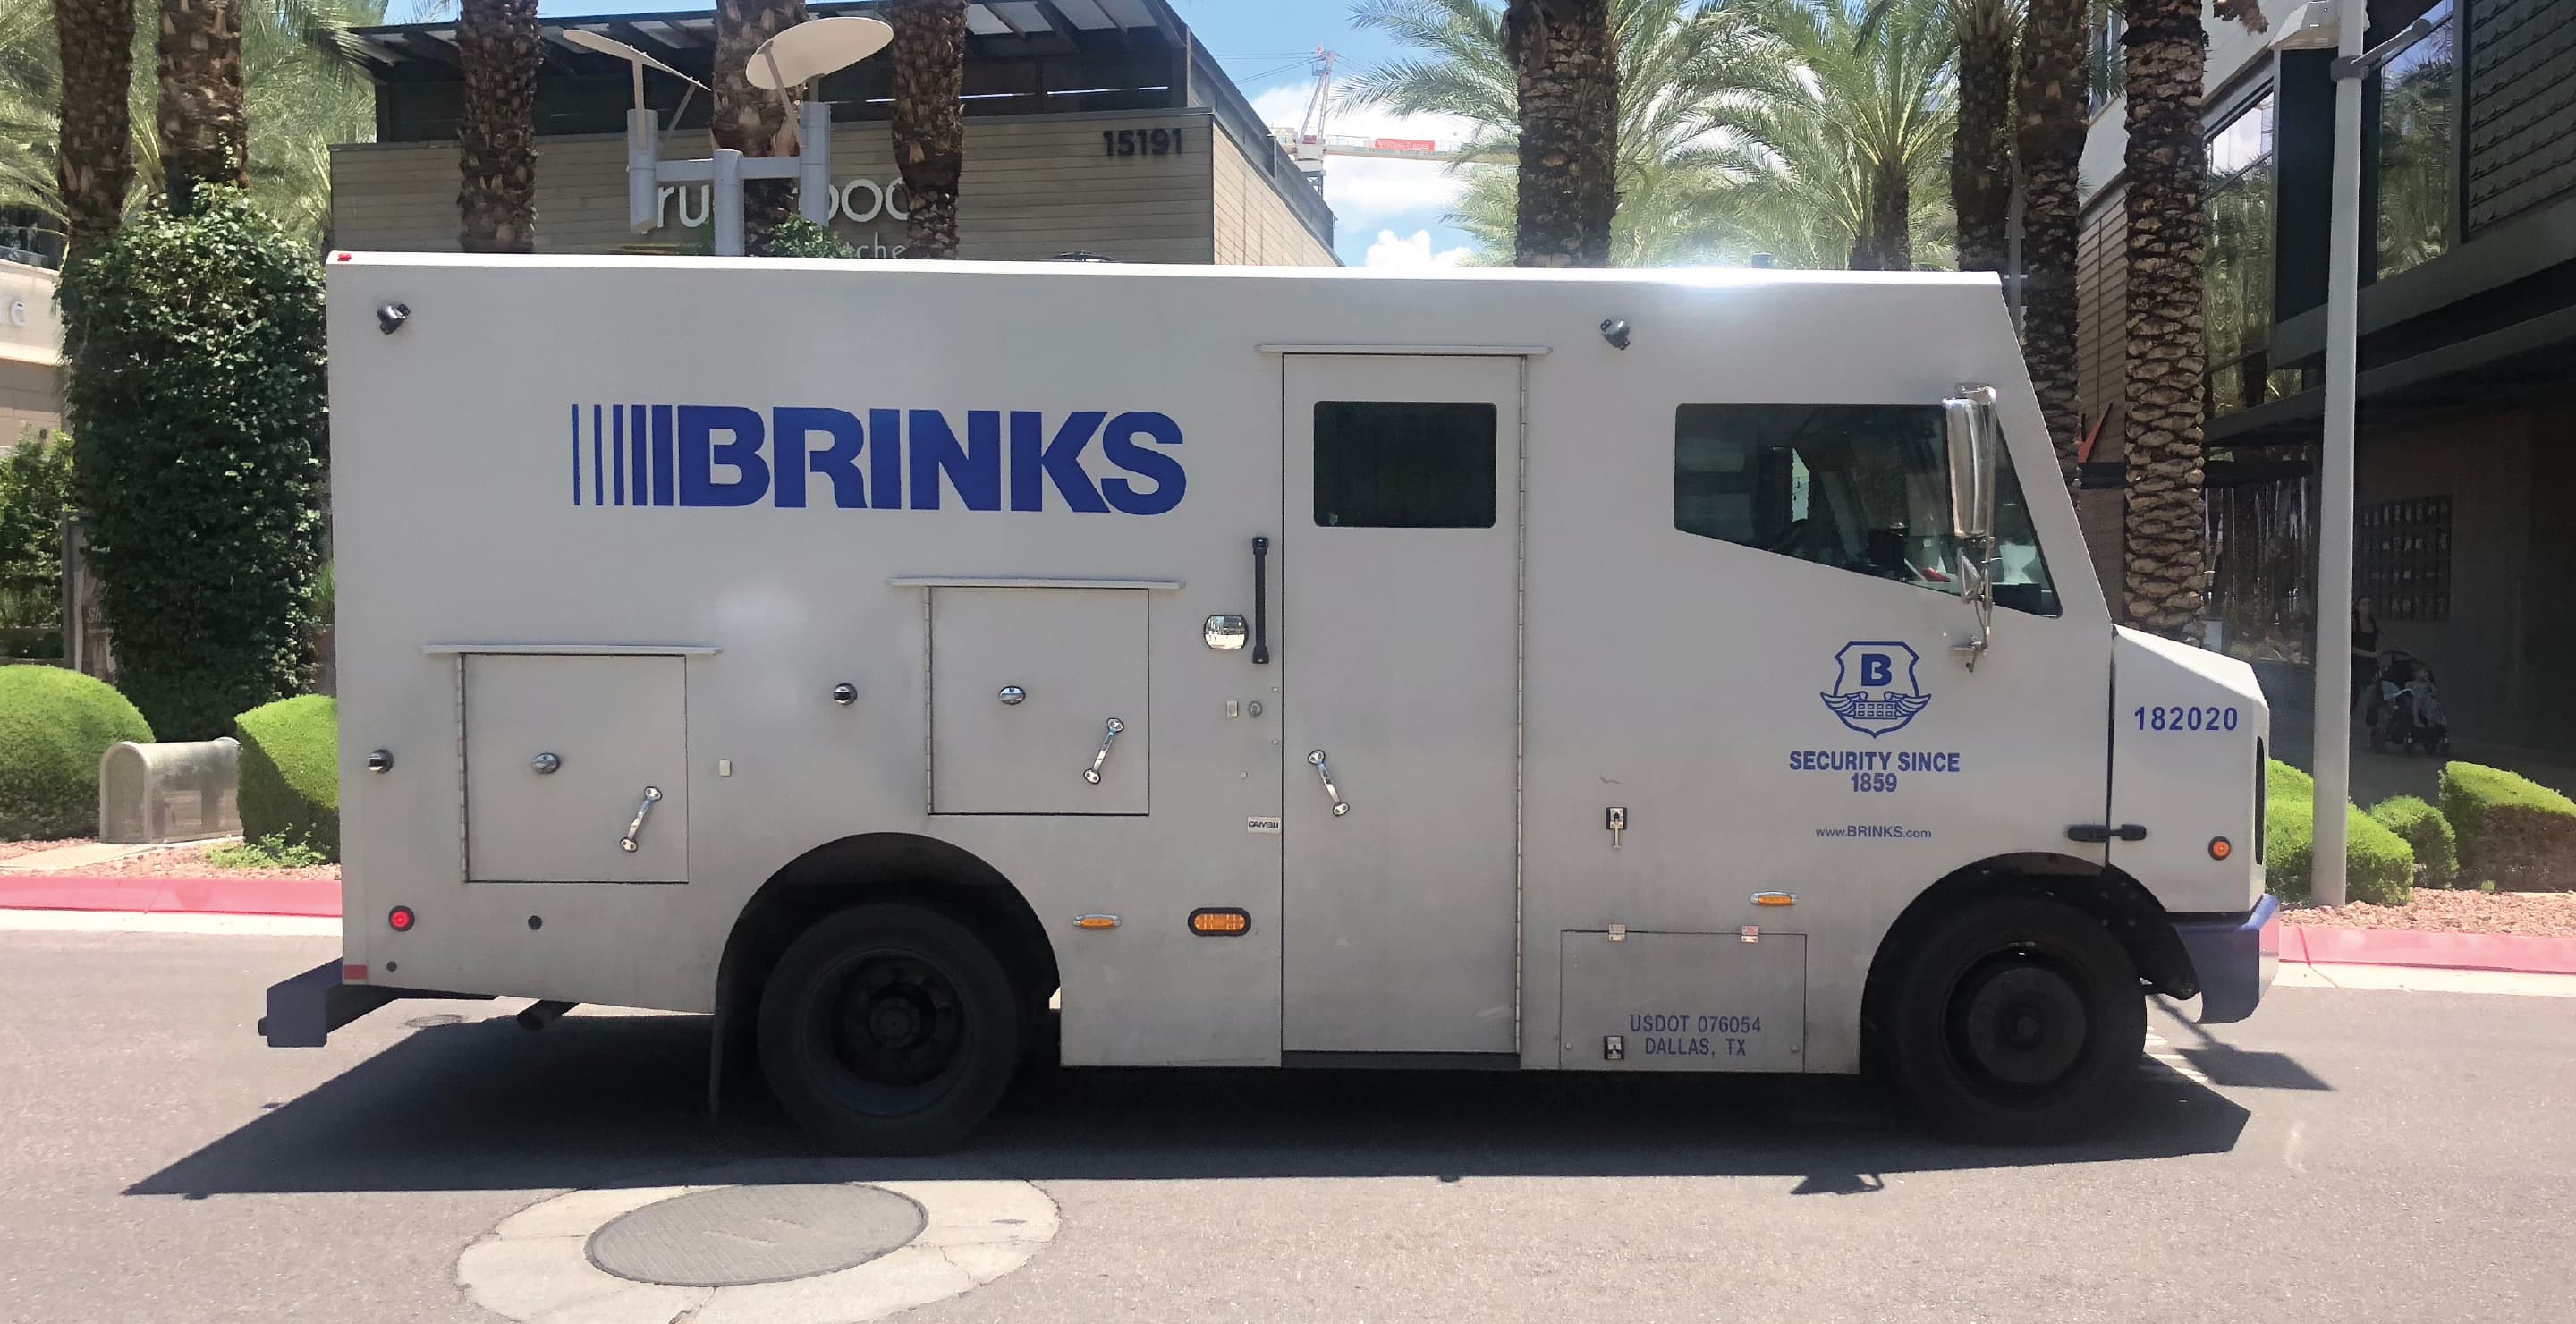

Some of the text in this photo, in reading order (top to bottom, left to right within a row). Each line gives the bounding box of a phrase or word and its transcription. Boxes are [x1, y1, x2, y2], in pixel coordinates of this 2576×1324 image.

[1103, 128, 1182, 157] 15191
[678, 405, 1187, 516] BRINKS
[1861, 654, 1893, 687] B
[2134, 707, 2239, 731] 182020
[1789, 751, 1961, 772] SECURITY SINCE
[1851, 773, 1897, 793] 1859
[1815, 825, 1932, 839] www.BRINKS.com
[1631, 1014, 1761, 1033] USDOT 076054
[1645, 1037, 1746, 1059] DALLAS, TX
